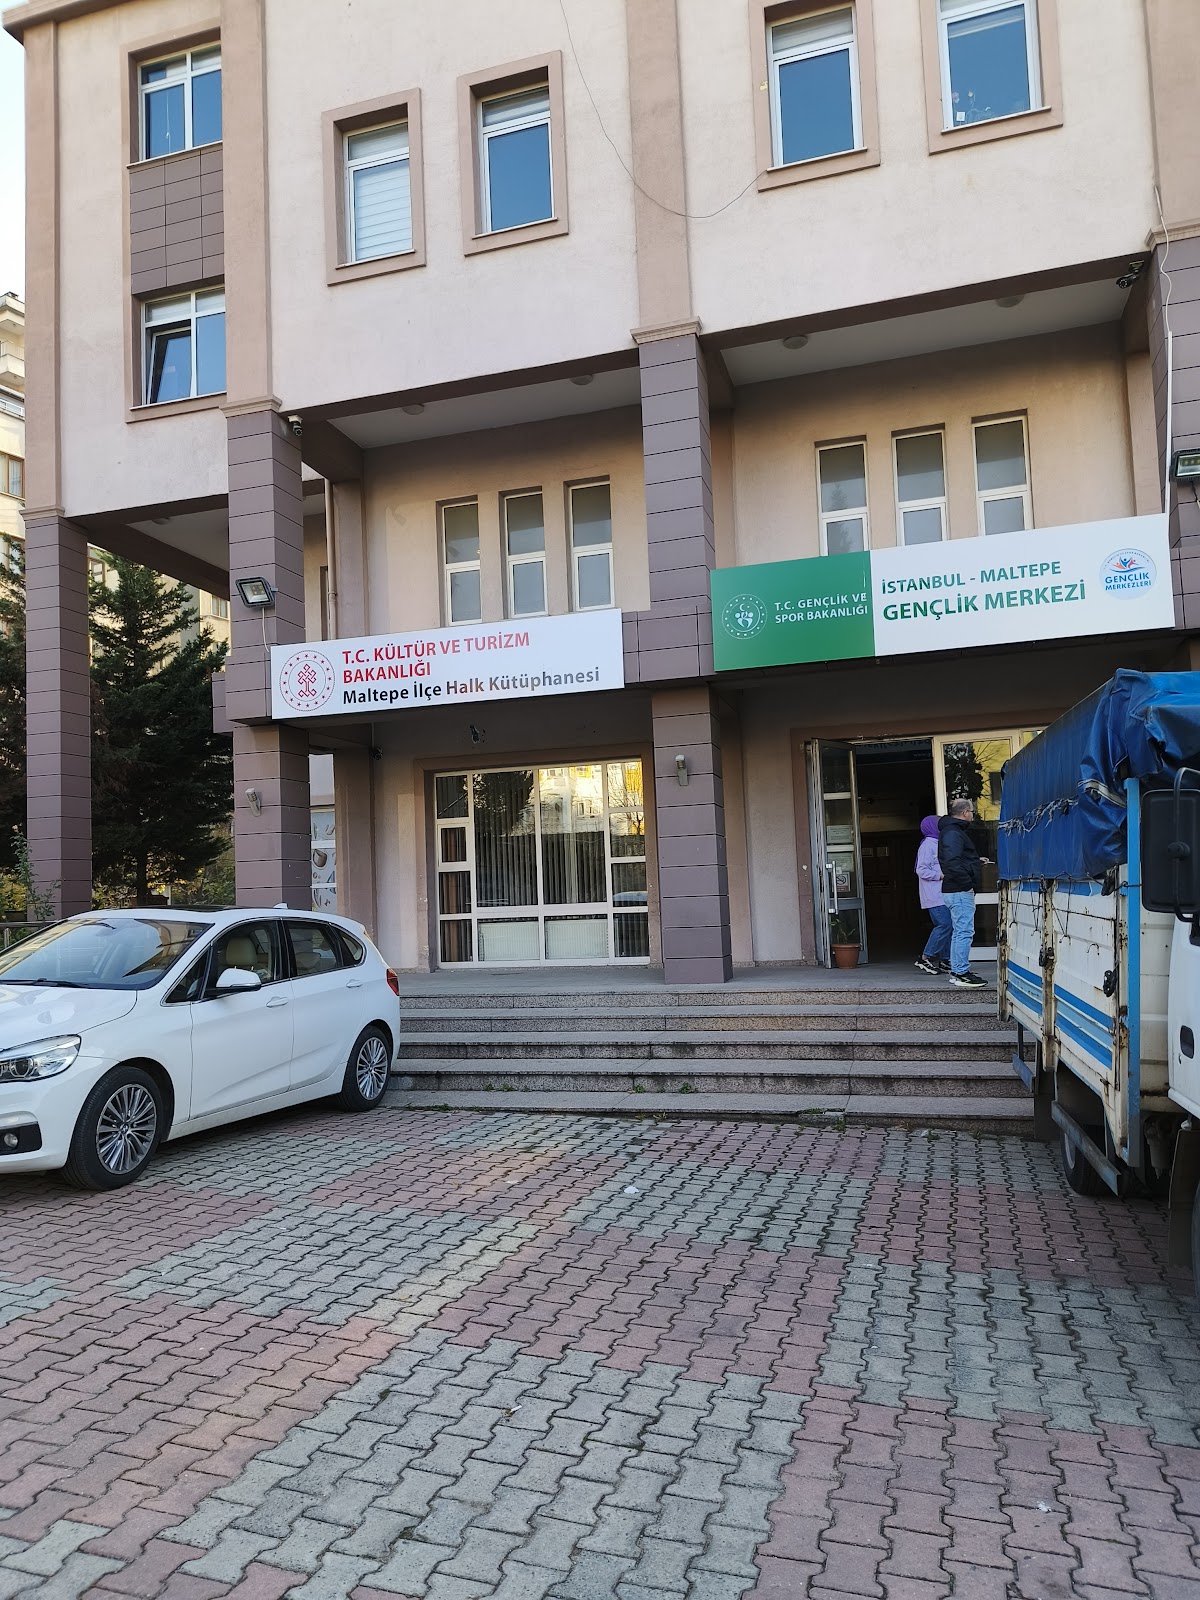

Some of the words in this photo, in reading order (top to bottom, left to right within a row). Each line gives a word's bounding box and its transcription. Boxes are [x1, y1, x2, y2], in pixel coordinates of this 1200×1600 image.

[881, 573, 965, 595] İSTANBUL
[980, 561, 1061, 583] MALTEPE
[774, 601, 795, 611] T.C.
[797, 593, 848, 609] GENÇLİK
[852, 592, 867, 602] VE
[775, 612, 804, 624] SPOR
[807, 604, 868, 621] BAKANLIĞI
[883, 593, 979, 620] GENÇLİK
[985, 579, 1086, 610] MERKEZİ
[342, 649, 370, 665] T.C.
[374, 640, 436, 662] KÜLTÜR
[440, 639, 461, 655] VE
[464, 631, 530, 652] TURİZM
[343, 660, 431, 684] BAKANLIĞI
[343, 687, 409, 704] Maltepe
[413, 681, 442, 700] İlçe
[446, 677, 485, 695] Halk
[489, 667, 600, 691] Kütüphanesi
